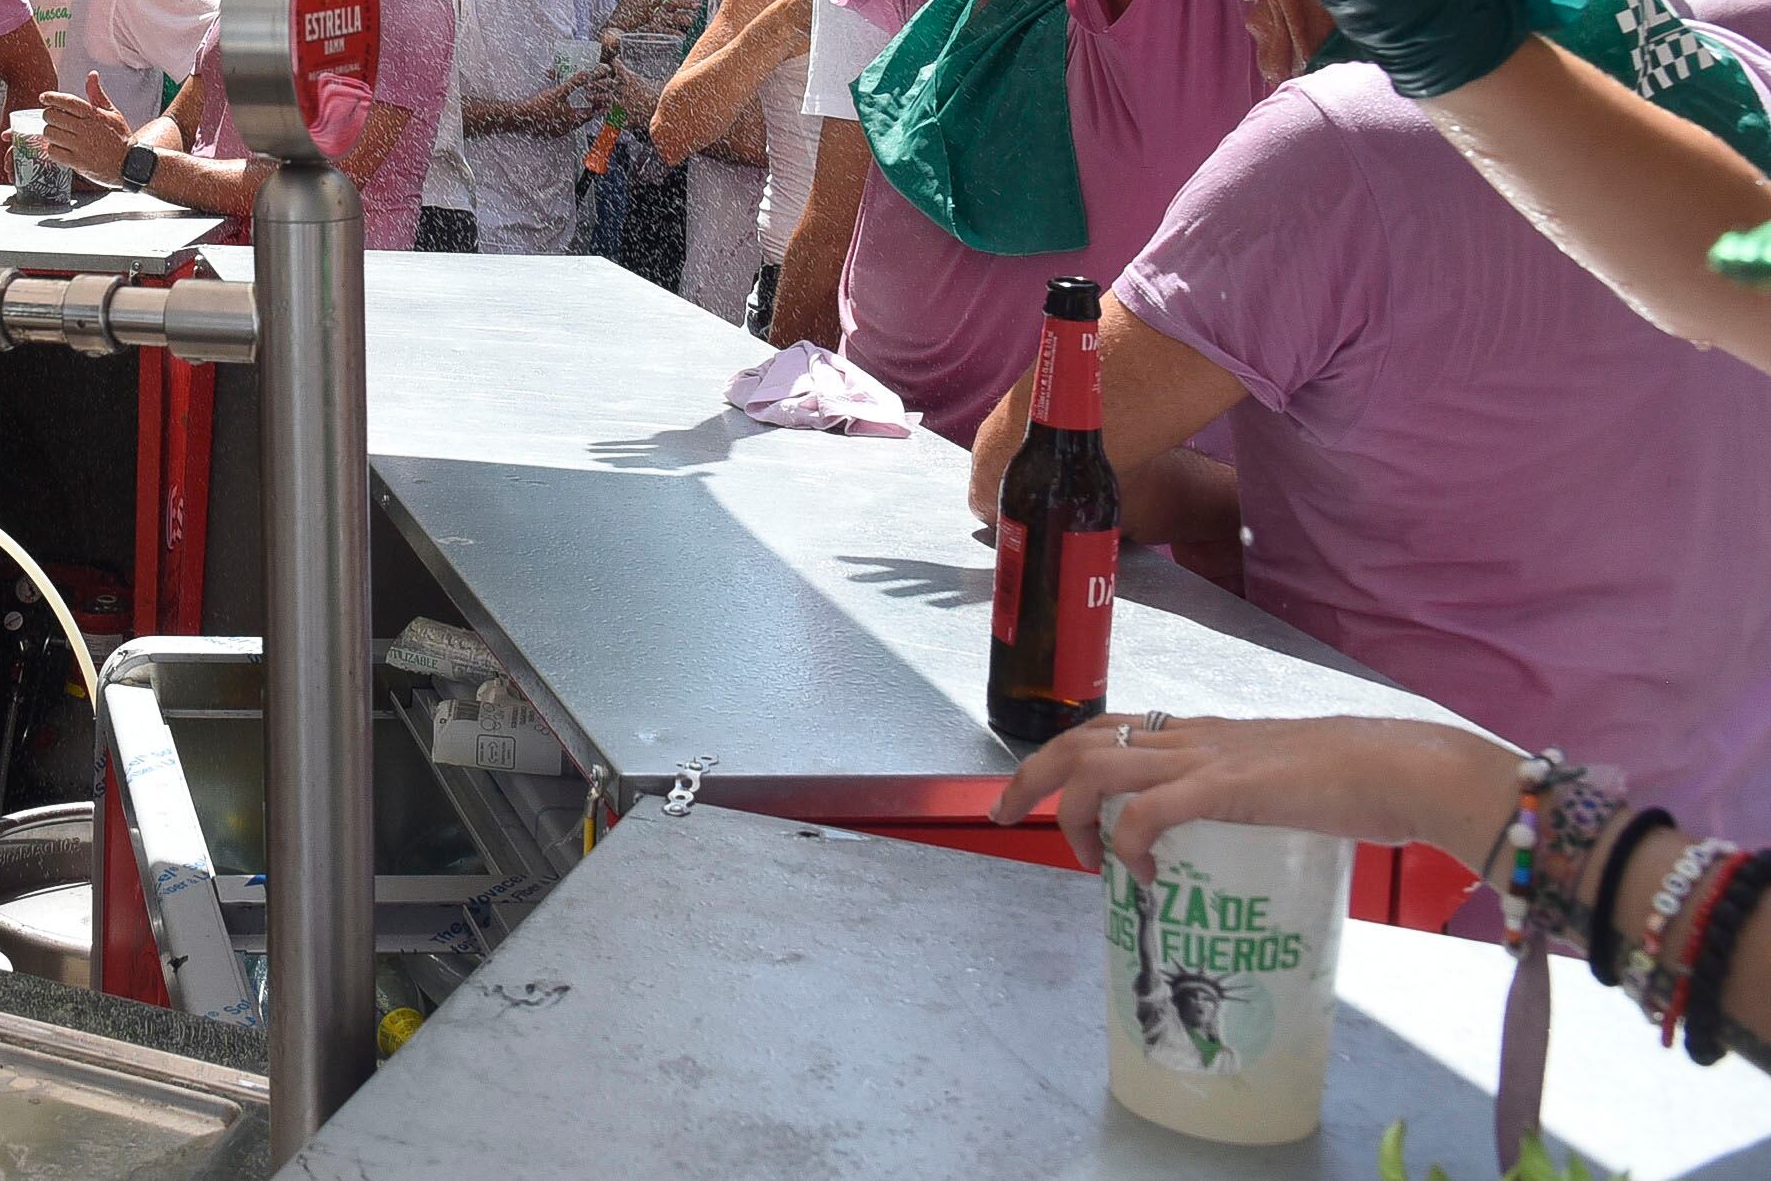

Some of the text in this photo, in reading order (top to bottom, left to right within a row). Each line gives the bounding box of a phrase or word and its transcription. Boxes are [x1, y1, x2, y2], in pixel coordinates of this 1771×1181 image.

[305, 5, 362, 42] ESTRELLA
[324, 37, 345, 56] DAMM
[1219, 895, 1270, 933] DE
[1161, 929, 1301, 973] FUEROS
